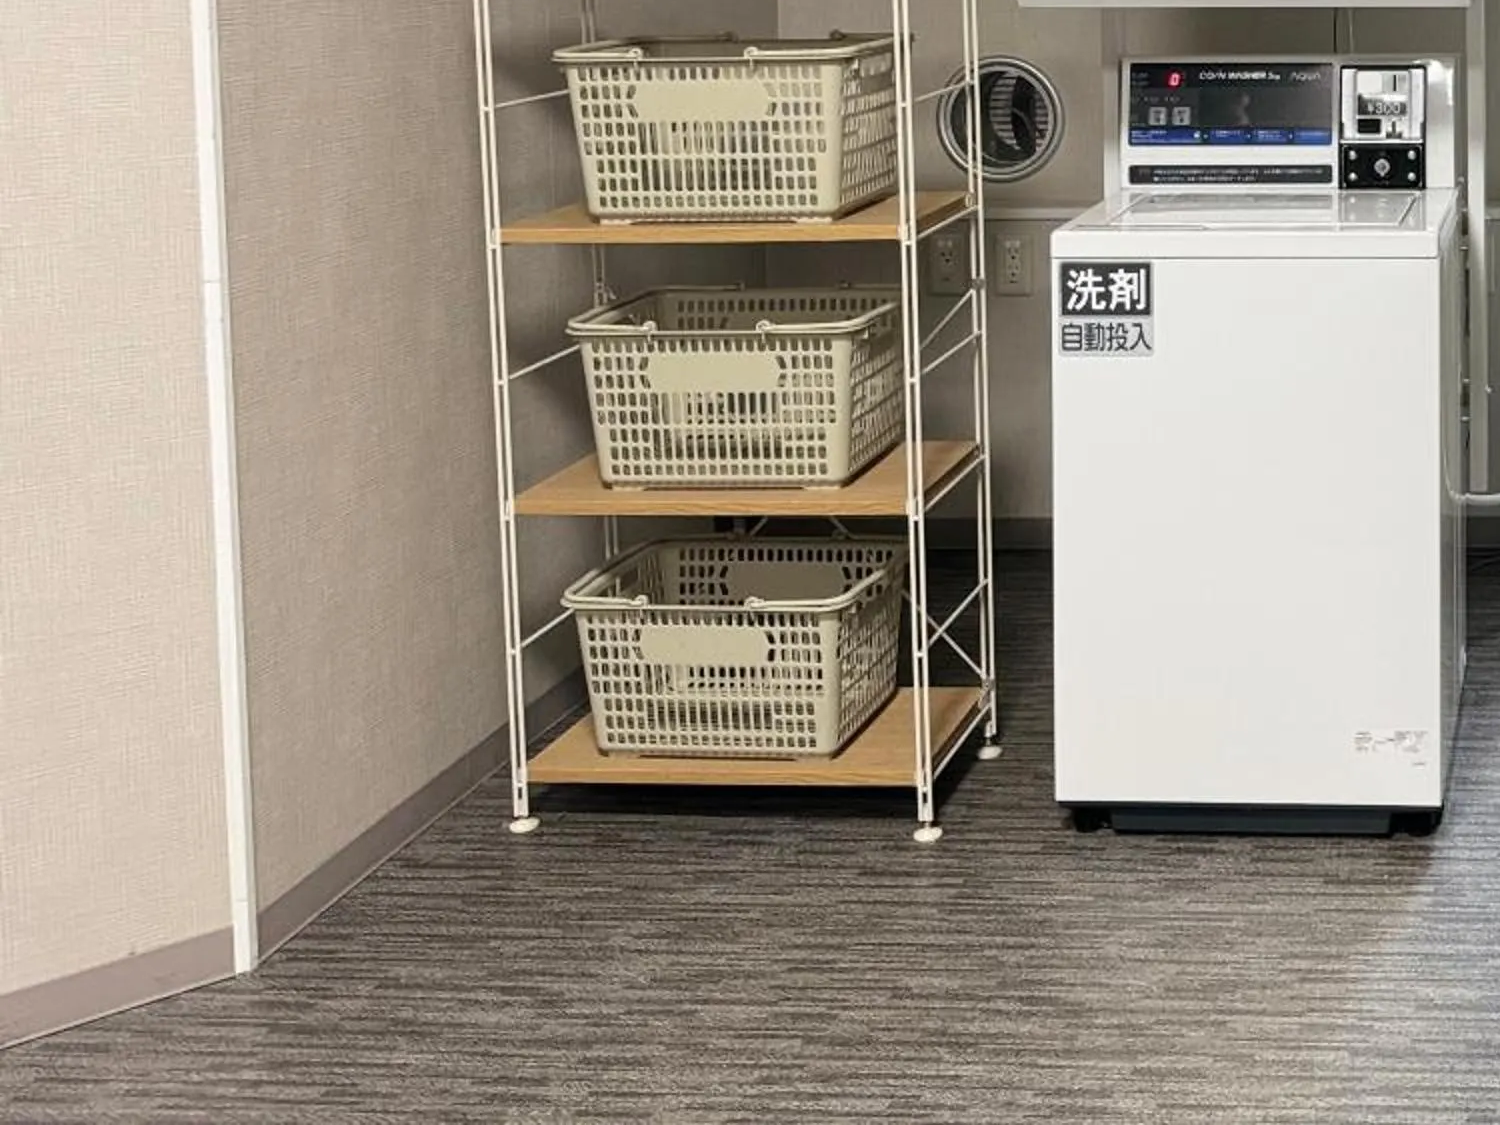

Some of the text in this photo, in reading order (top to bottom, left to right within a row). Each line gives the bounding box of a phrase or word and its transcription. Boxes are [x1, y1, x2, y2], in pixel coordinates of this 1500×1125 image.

[1067, 268, 1147, 311] 洗剤
[1061, 321, 1152, 352] 自動投入
